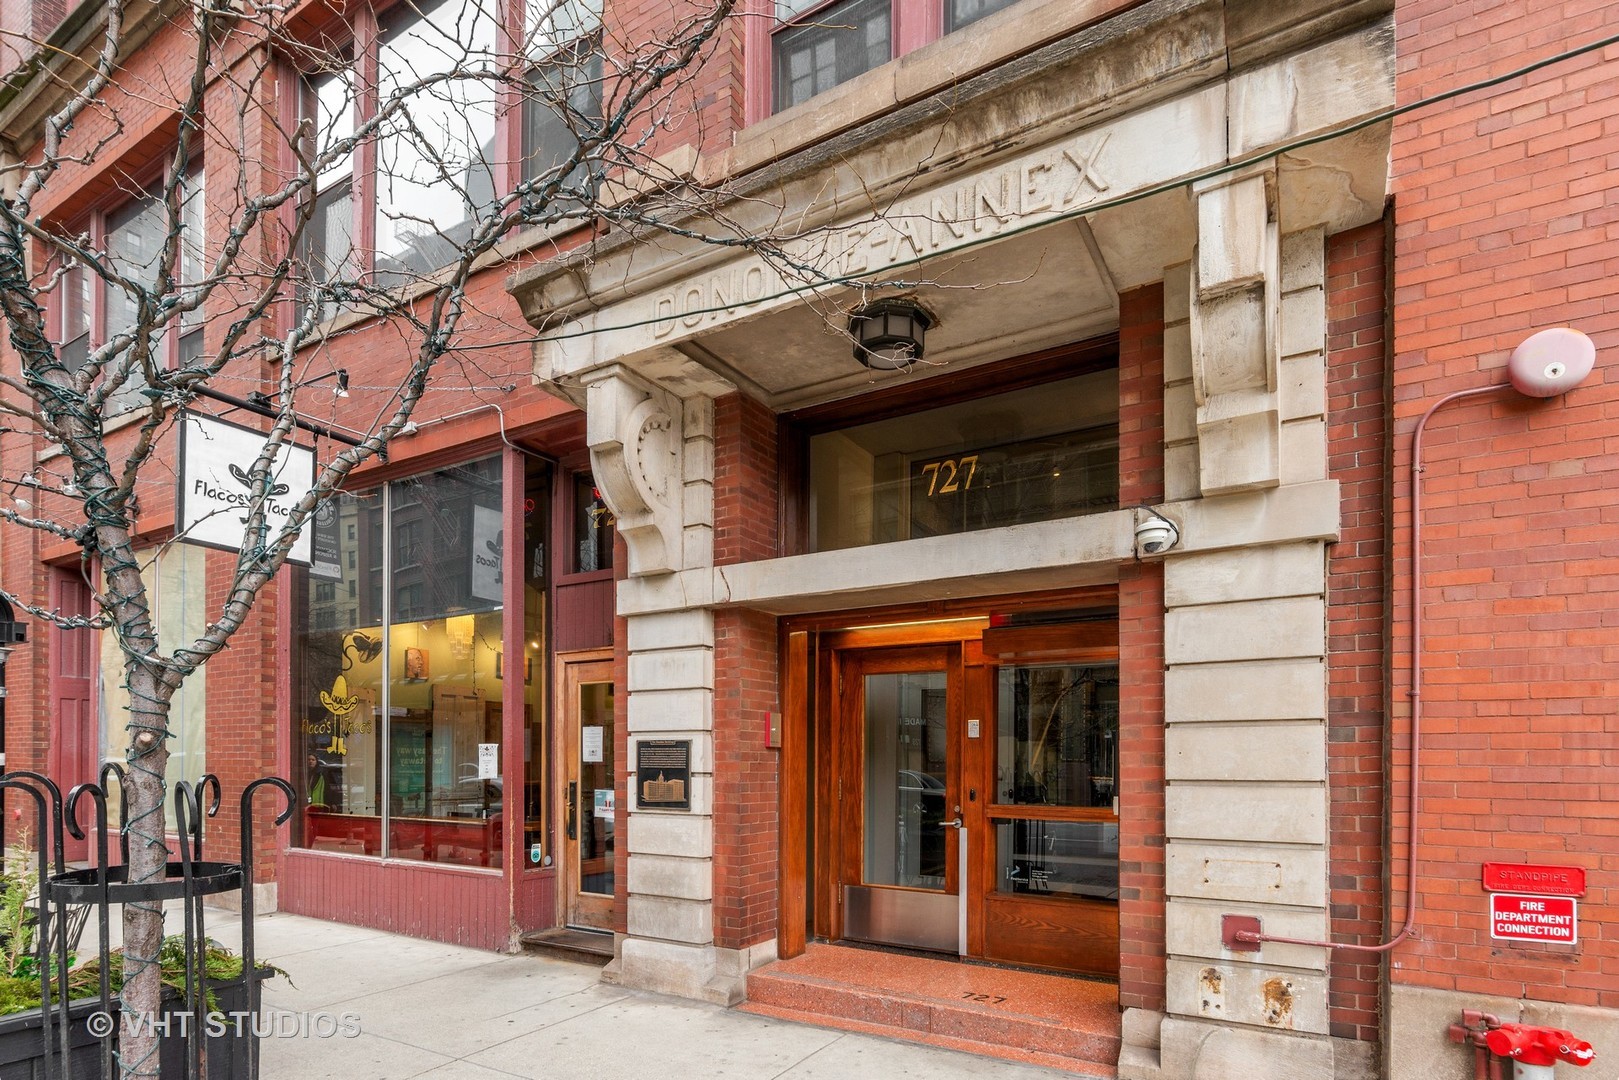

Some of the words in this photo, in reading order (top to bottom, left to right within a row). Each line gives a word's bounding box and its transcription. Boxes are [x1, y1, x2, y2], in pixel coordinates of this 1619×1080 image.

[921, 454, 979, 497] 727
[265, 498, 289, 516] Tac
[591, 507, 616, 529] 72
[1500, 870, 1569, 883] STANDPIPE
[1520, 901, 1545, 911] FIRE
[1495, 911, 1571, 925] DEPARTMENT
[1497, 923, 1570, 937] CONNECTION
[962, 991, 1008, 1004] 727
